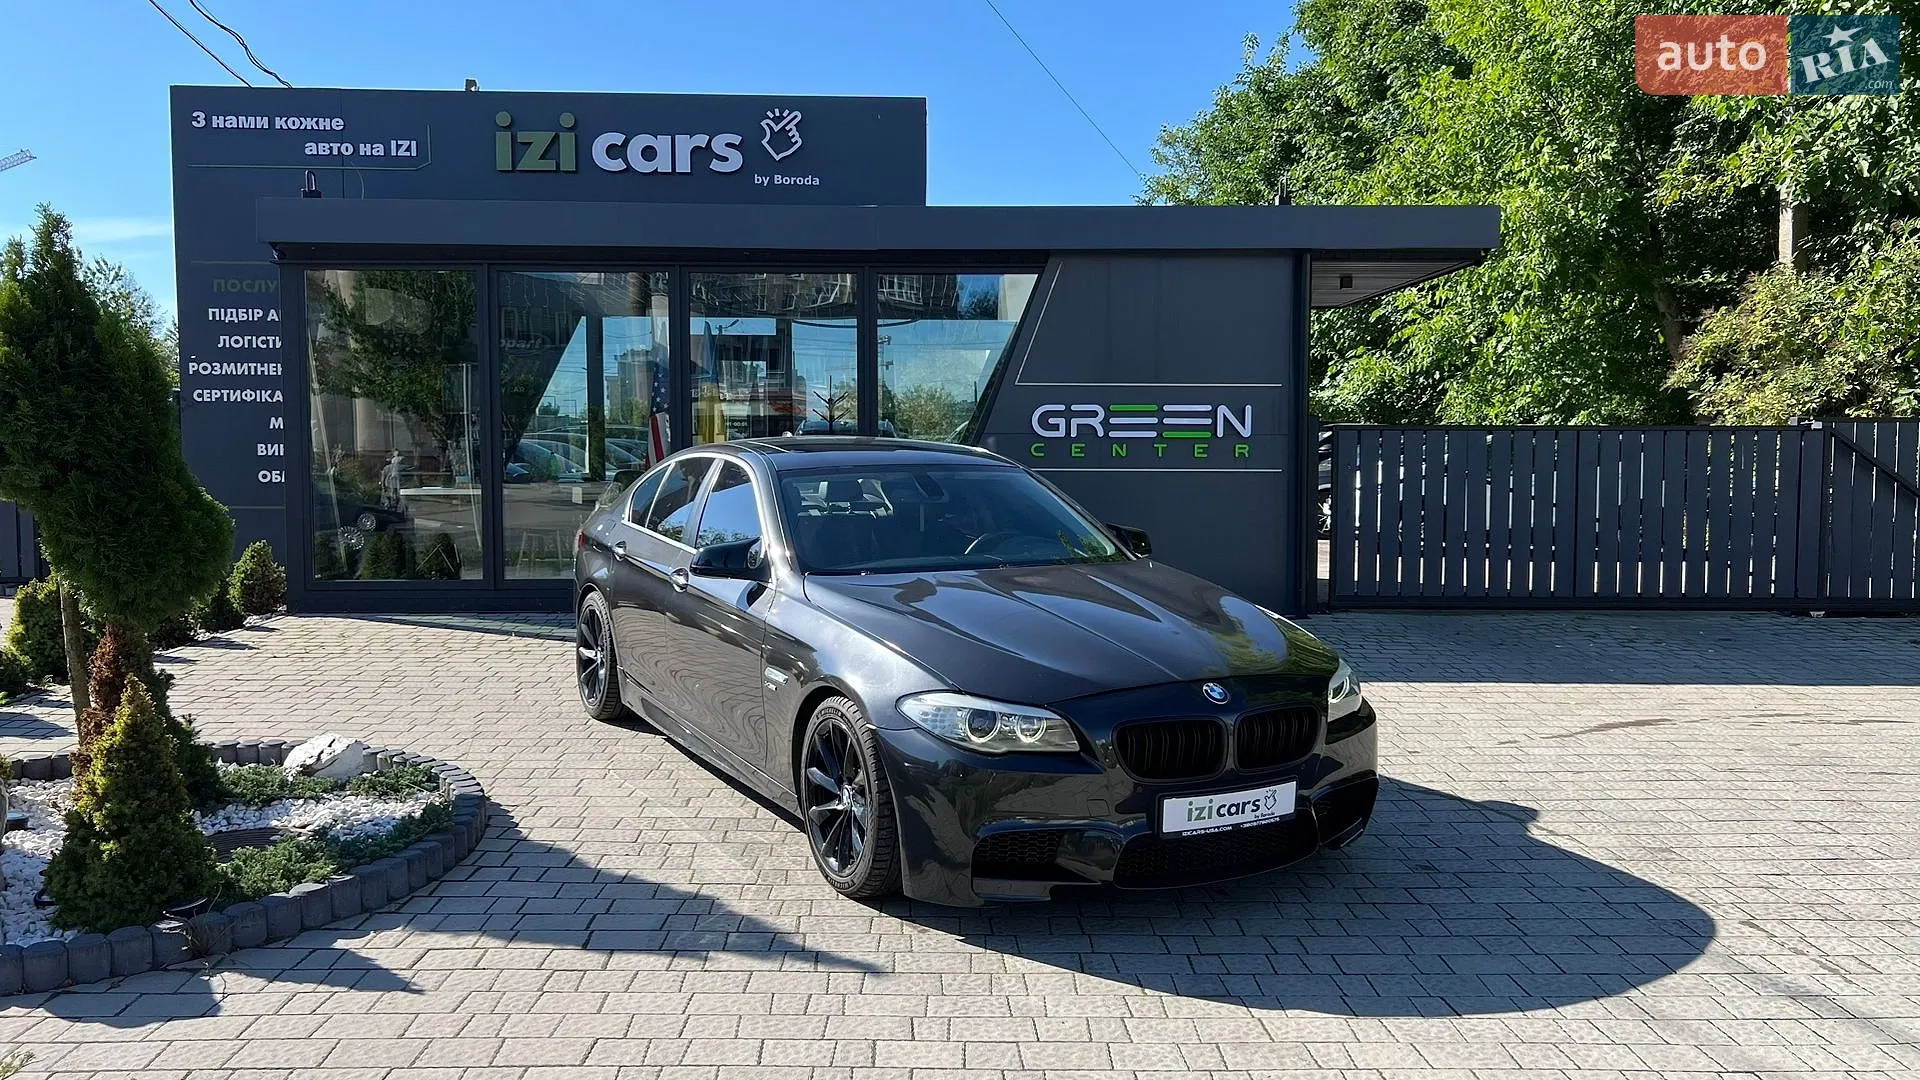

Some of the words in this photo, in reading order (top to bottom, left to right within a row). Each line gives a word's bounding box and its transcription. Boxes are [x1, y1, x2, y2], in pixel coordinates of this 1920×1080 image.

[191, 111, 207, 128] З
[211, 114, 269, 130] нами
[275, 115, 345, 131] кожне
[304, 140, 354, 156] авто
[359, 141, 385, 156] на
[390, 140, 417, 157] IZI
[495, 111, 577, 172] izi
[592, 131, 744, 173] cars
[754, 173, 770, 186] by
[774, 174, 820, 186] Boroda
[208, 308, 264, 323] ПІДБІР
[267, 309, 282, 321] А
[193, 389, 284, 402] СЕРТИФІКА
[1031, 404, 1252, 438] GREEN
[1030, 443, 1250, 457] CENTER
[1187, 798, 1213, 822] izi
[1216, 798, 1261, 818] cars
